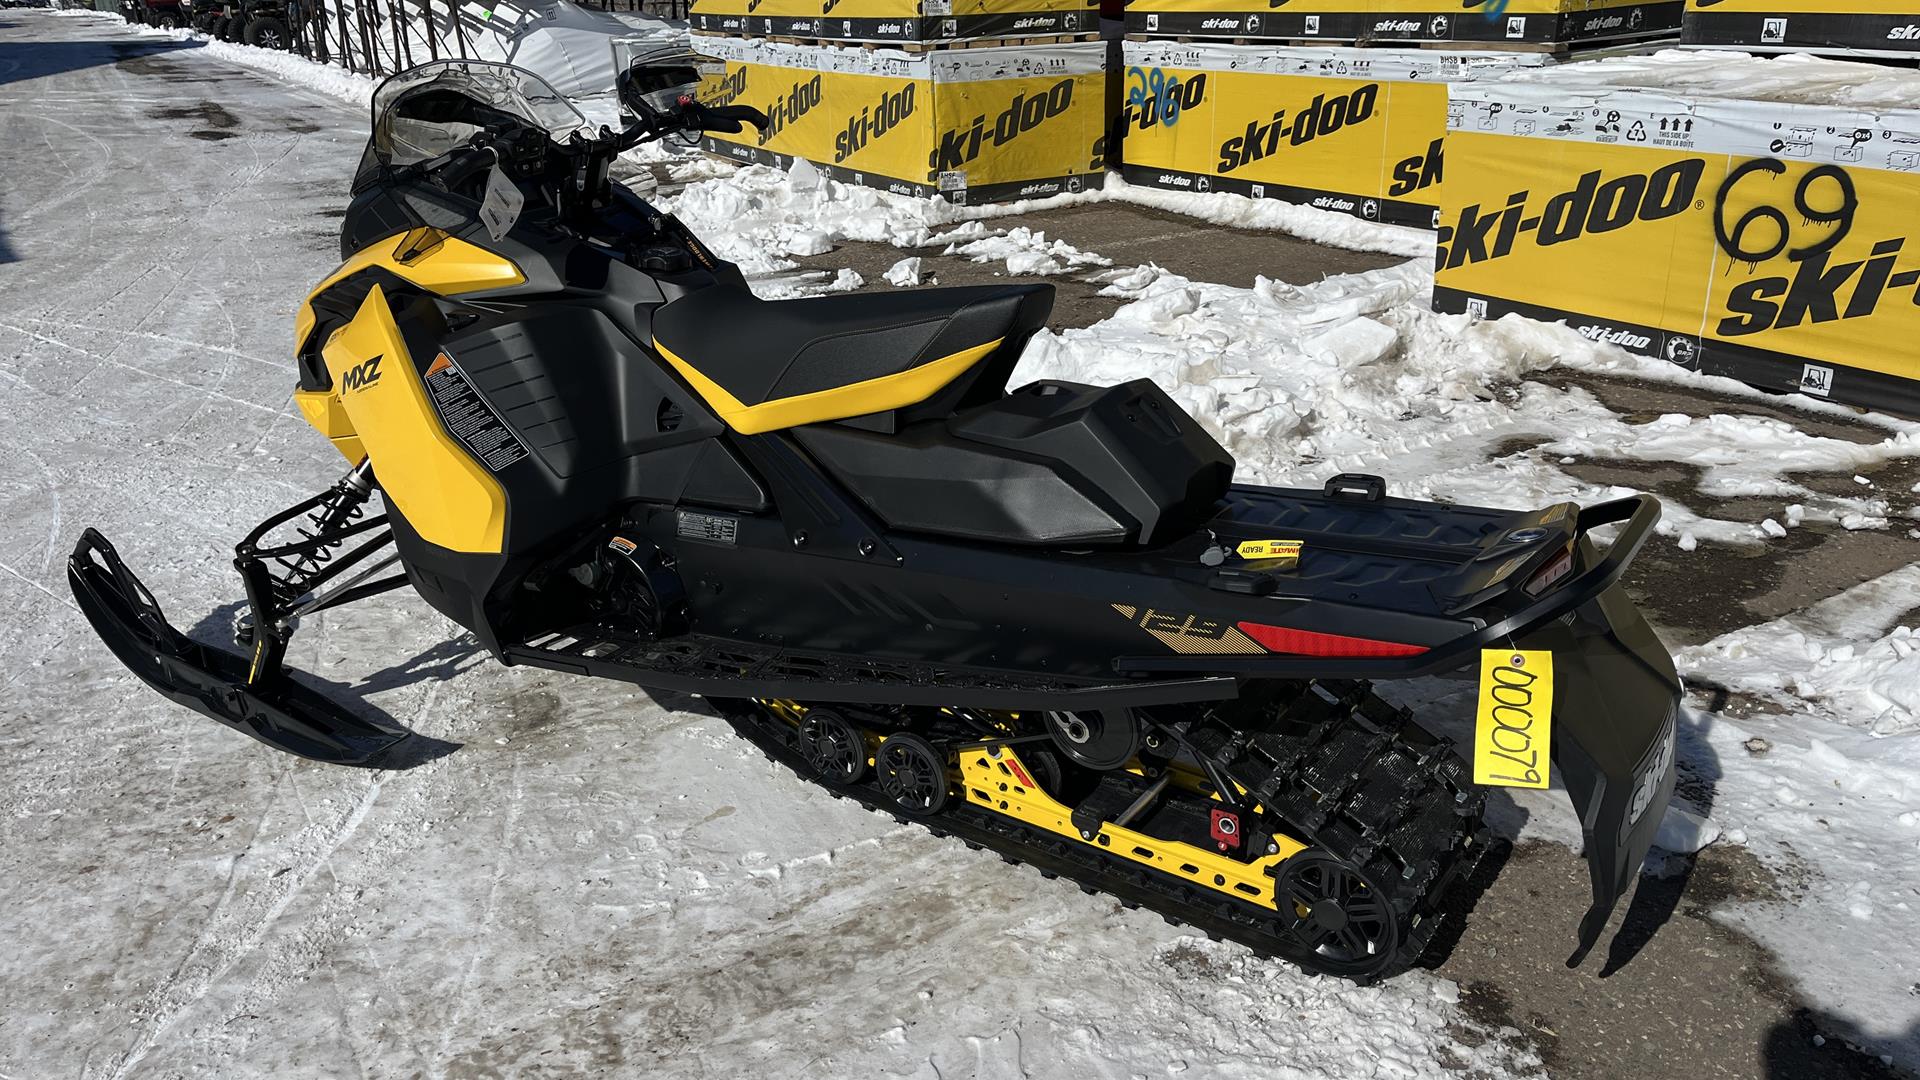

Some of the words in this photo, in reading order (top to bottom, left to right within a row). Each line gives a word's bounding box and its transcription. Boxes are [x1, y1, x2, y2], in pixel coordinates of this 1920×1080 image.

[792, 22, 811, 31] ski-doo
[877, 23, 900, 34] ski-doo
[1014, 17, 1056, 28] ski-doo
[1202, 18, 1239, 29] ski-doo
[1374, 19, 1421, 32] ski-doo
[1584, 15, 1622, 32] ski-doo
[1128, 66, 1181, 127] 296
[835, 82, 916, 163] ski-doo
[1217, 83, 1379, 174] ski-doo
[1659, 131, 1670, 139] THIS
[1671, 132, 1682, 140] SIDE
[1158, 173, 1191, 187] ski-doo
[889, 183, 911, 195] ski-doo
[1020, 183, 1059, 195] ski-doo
[1312, 196, 1355, 211] ski-doo
[1714, 157, 1858, 264] 69
[1578, 325, 1651, 349] ski-doo
[342, 353, 385, 395] MXZ
[1241, 545, 1264, 554] READY
[1489, 666, 1542, 784] 000079
